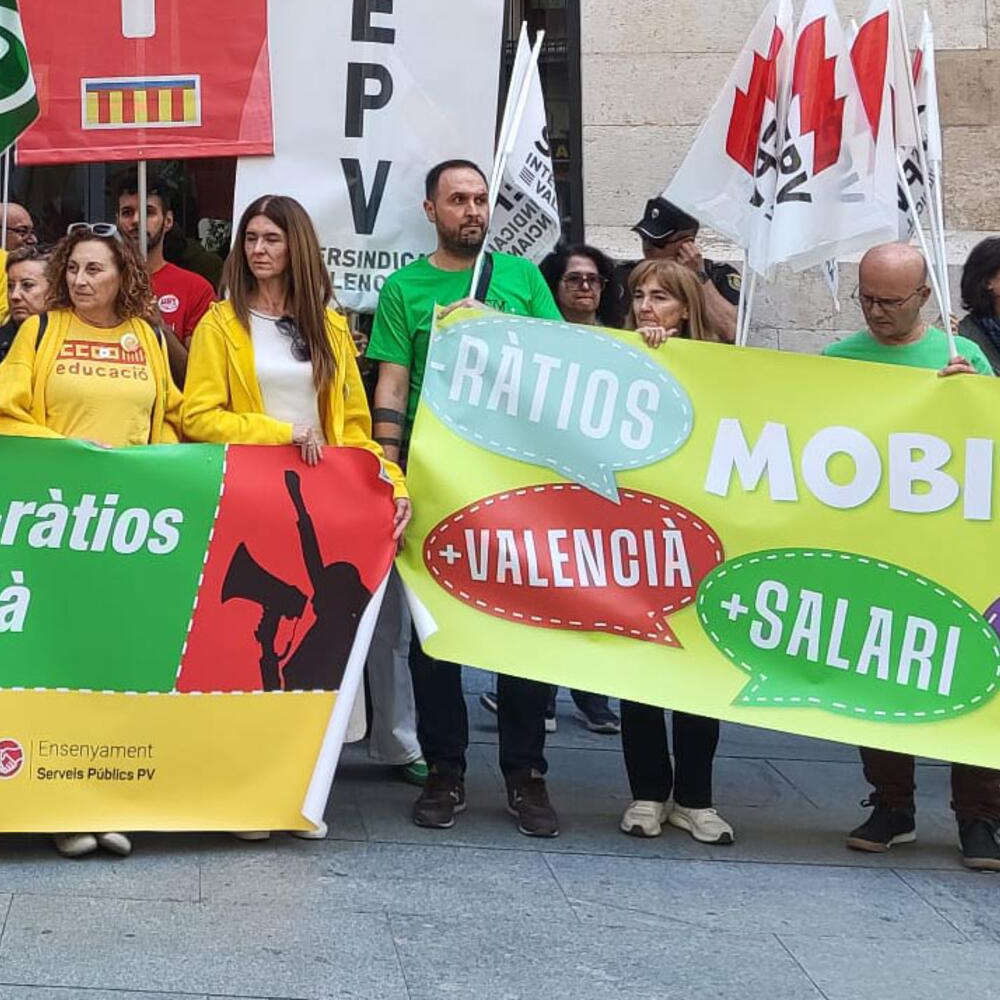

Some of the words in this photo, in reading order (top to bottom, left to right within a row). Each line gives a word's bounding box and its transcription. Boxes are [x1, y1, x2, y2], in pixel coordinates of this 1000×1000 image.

[56, 361, 149, 381] educació
[430, 331, 661, 451] -RÀTIOS
[439, 517, 693, 588] +VALENCIÀ
[720, 579, 962, 697] +SALARI
[36, 766, 84, 780] Serveis
[87, 766, 134, 781] Públics
[137, 767, 156, 781] PV
[38, 740, 154, 762] Ensenyament
